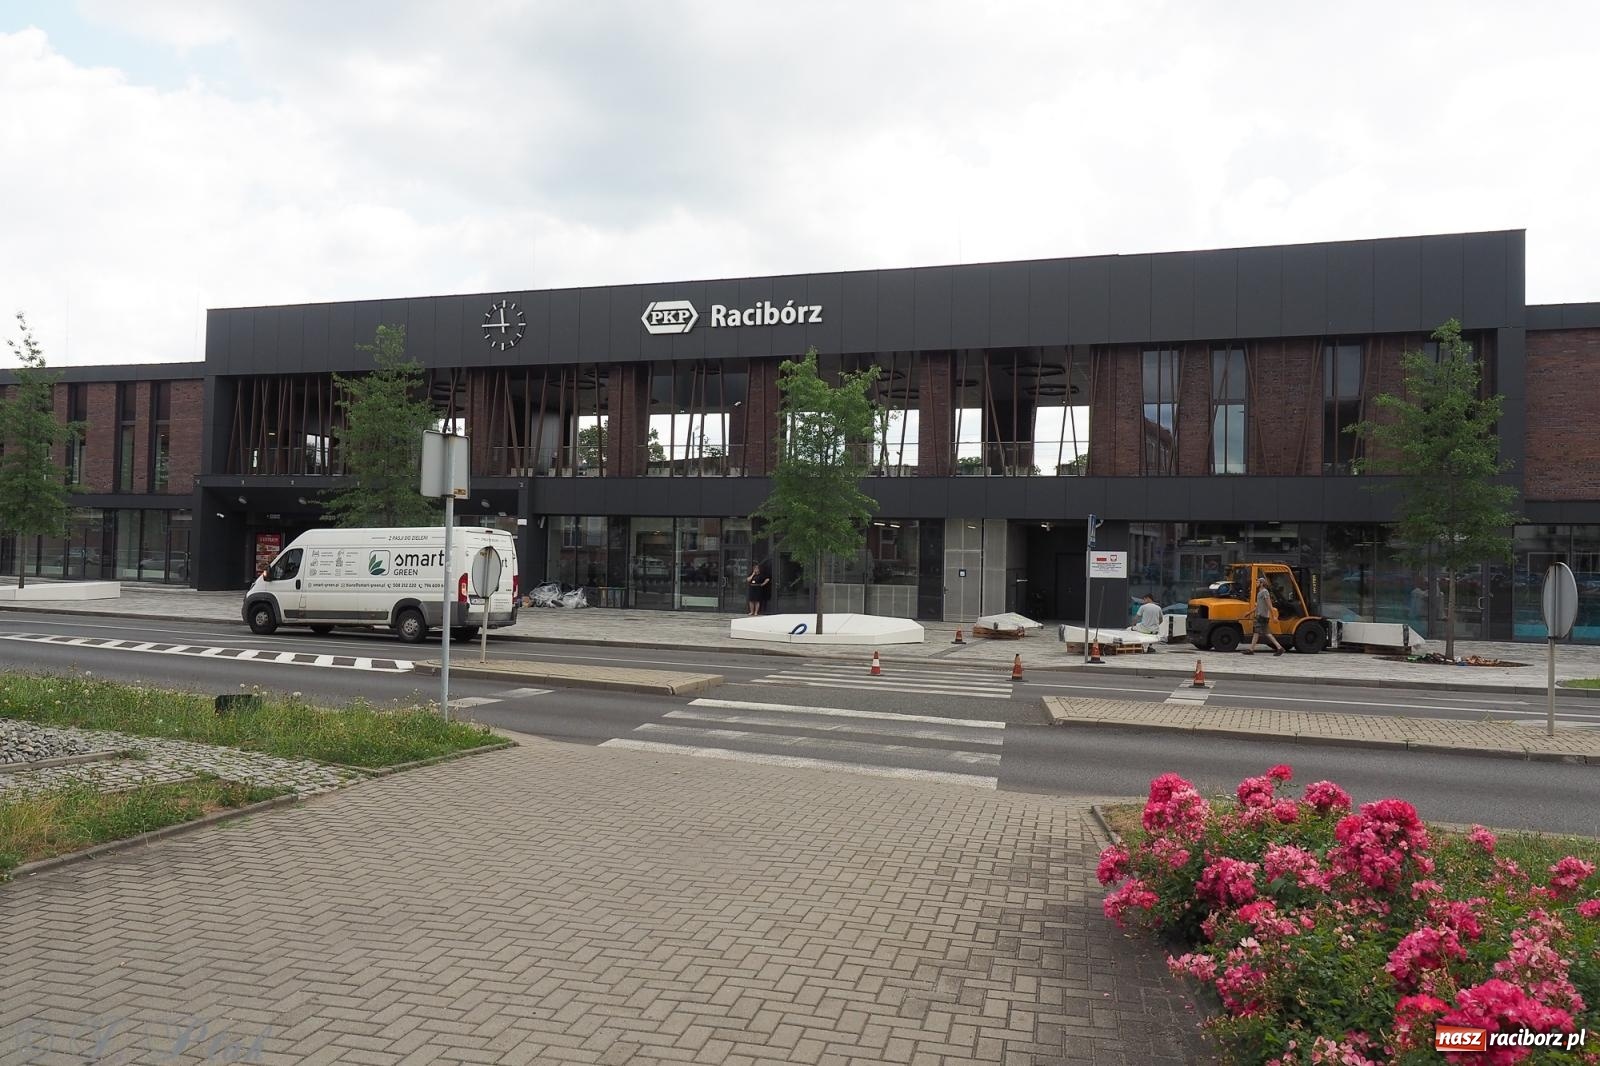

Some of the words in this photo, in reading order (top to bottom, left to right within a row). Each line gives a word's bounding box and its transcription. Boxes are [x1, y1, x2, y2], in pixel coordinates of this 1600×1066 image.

[650, 309, 690, 325] PKP
[711, 300, 823, 327] Racibórz
[394, 549, 445, 567] smart
[393, 568, 419, 576] GREEN
